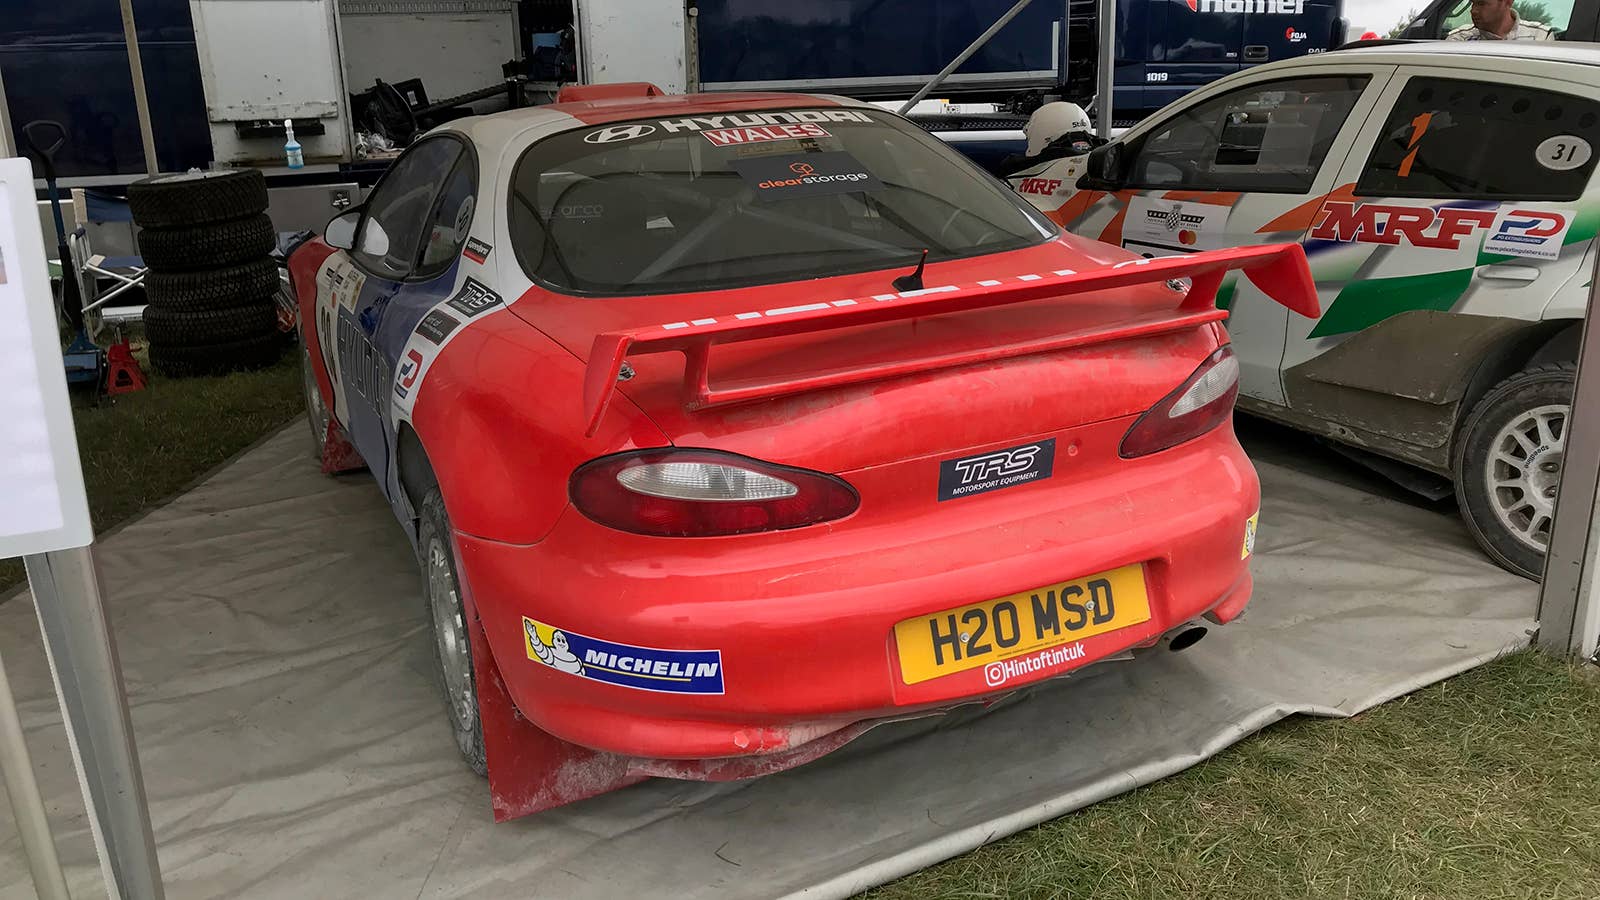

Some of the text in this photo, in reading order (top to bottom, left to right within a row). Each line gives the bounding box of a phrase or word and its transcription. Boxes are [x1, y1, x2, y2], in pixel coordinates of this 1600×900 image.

[1146, 72, 1168, 81] 1019
[659, 111, 875, 133] HYUNDAI
[705, 123, 826, 144] WALES
[1551, 143, 1577, 162] 31
[1019, 178, 1061, 196] MRF
[1311, 202, 1498, 250] MRF
[955, 445, 1041, 484] TRS
[952, 471, 1039, 495] MOTORSPORT EQUIPMENT
[1031, 578, 1115, 640] MSD
[585, 649, 719, 677] MICHELIN
[1004, 642, 1086, 679] Hintoftintuk
